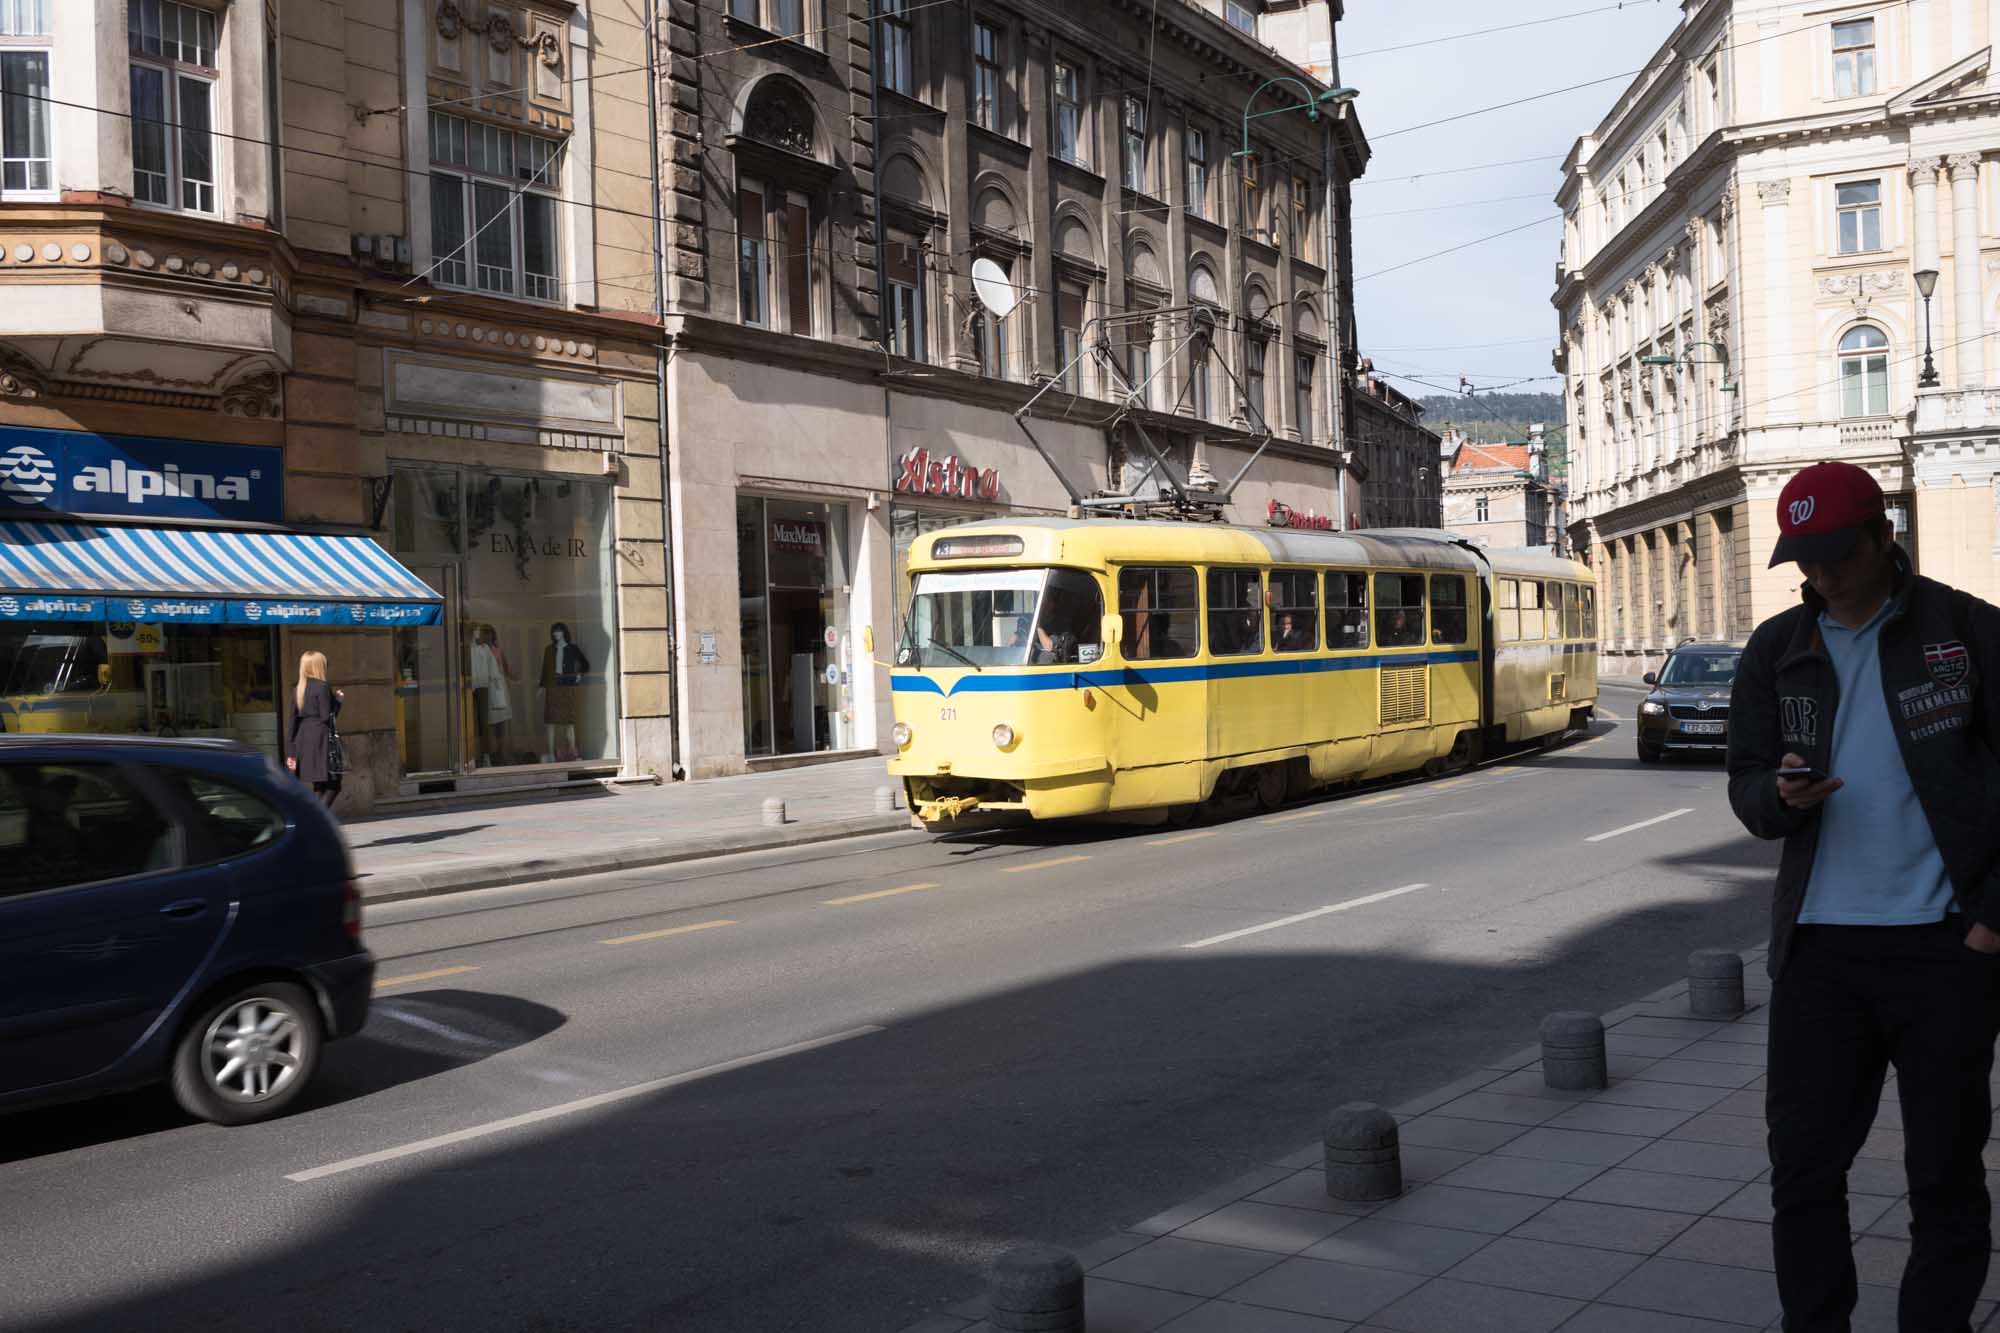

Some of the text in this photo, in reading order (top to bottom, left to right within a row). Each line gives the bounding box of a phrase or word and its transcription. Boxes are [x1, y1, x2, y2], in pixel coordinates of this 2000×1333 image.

[73, 459, 250, 503] alpina
[896, 446, 1000, 499] Astra
[1788, 495, 1815, 525] W
[773, 523, 821, 545] MaxMara
[543, 537, 561, 556] de
[567, 538, 587, 558] IR
[24, 599, 93, 613] alpina
[150, 602, 212, 616] alpina
[266, 605, 322, 619] alpina
[940, 707, 957, 721] 271
